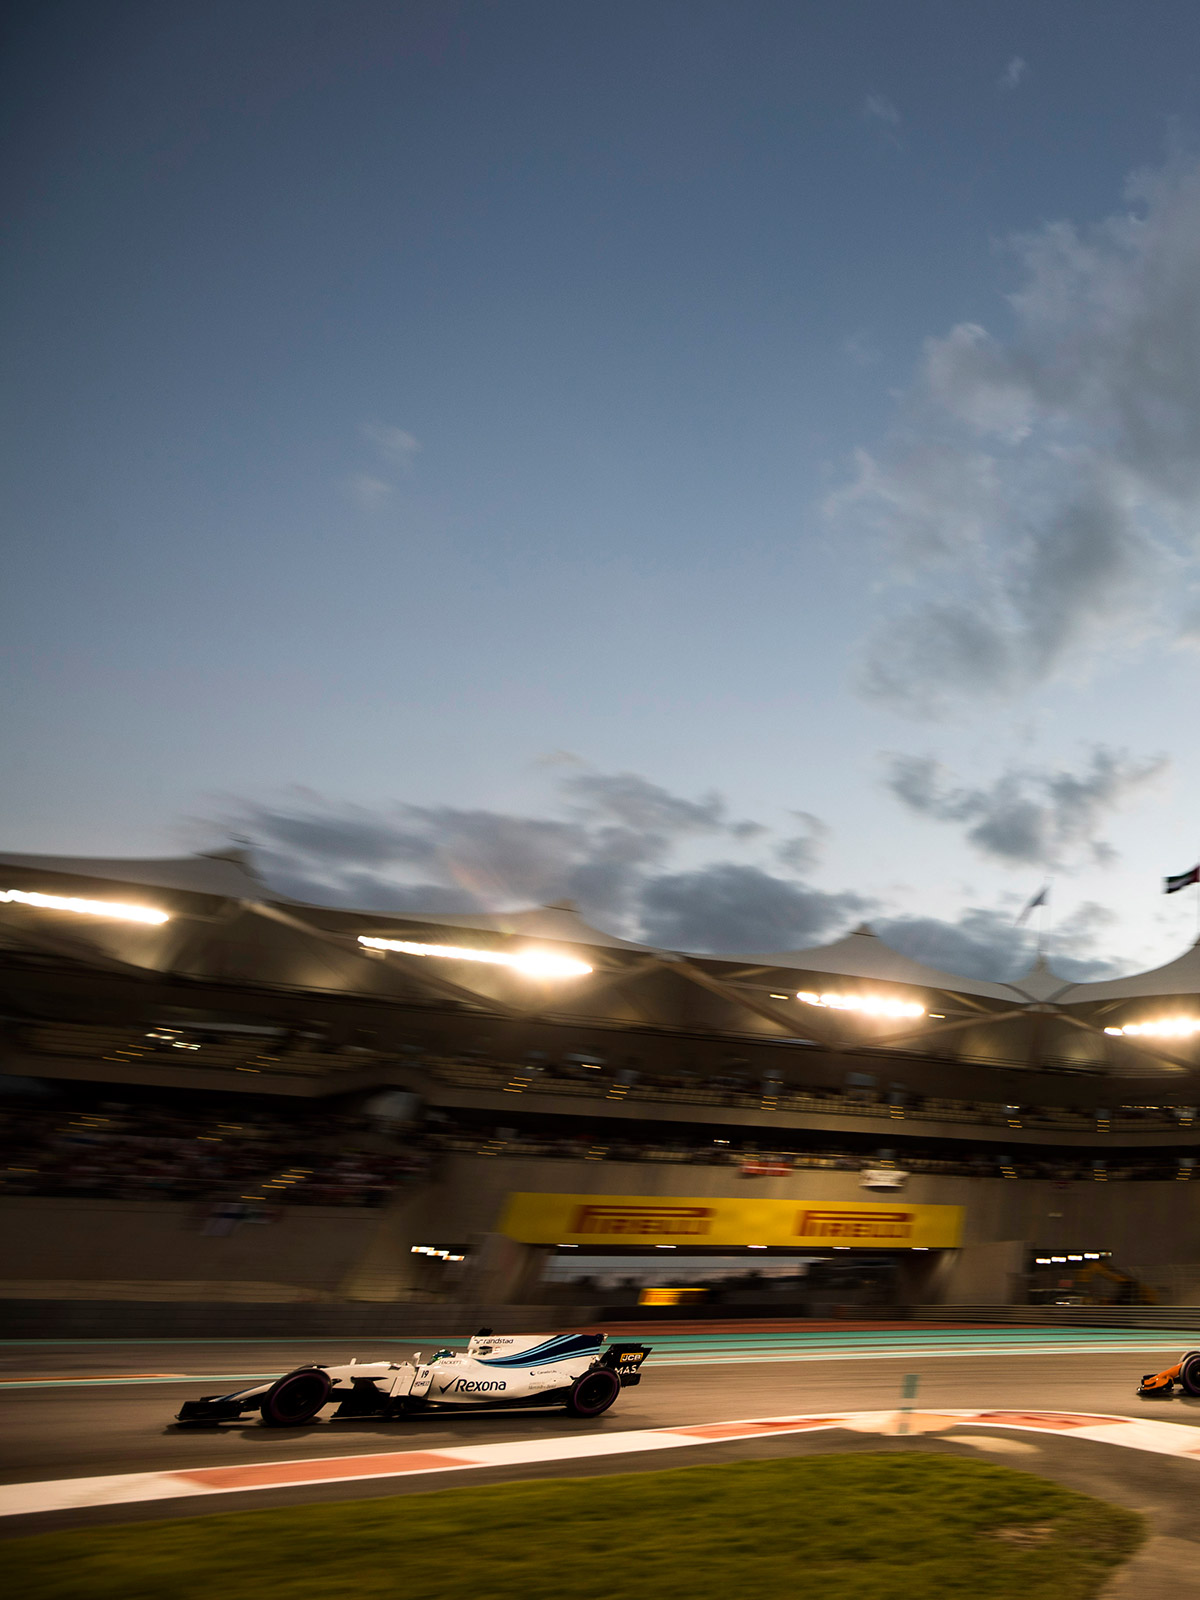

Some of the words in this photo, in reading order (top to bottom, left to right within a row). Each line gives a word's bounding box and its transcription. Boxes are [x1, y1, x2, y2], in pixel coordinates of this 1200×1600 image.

[569, 1204, 715, 1235] PIRELLI
[793, 1210, 914, 1238] PIRELLI
[421, 1370, 430, 1378] 19
[454, 1379, 507, 1393] Rexona
